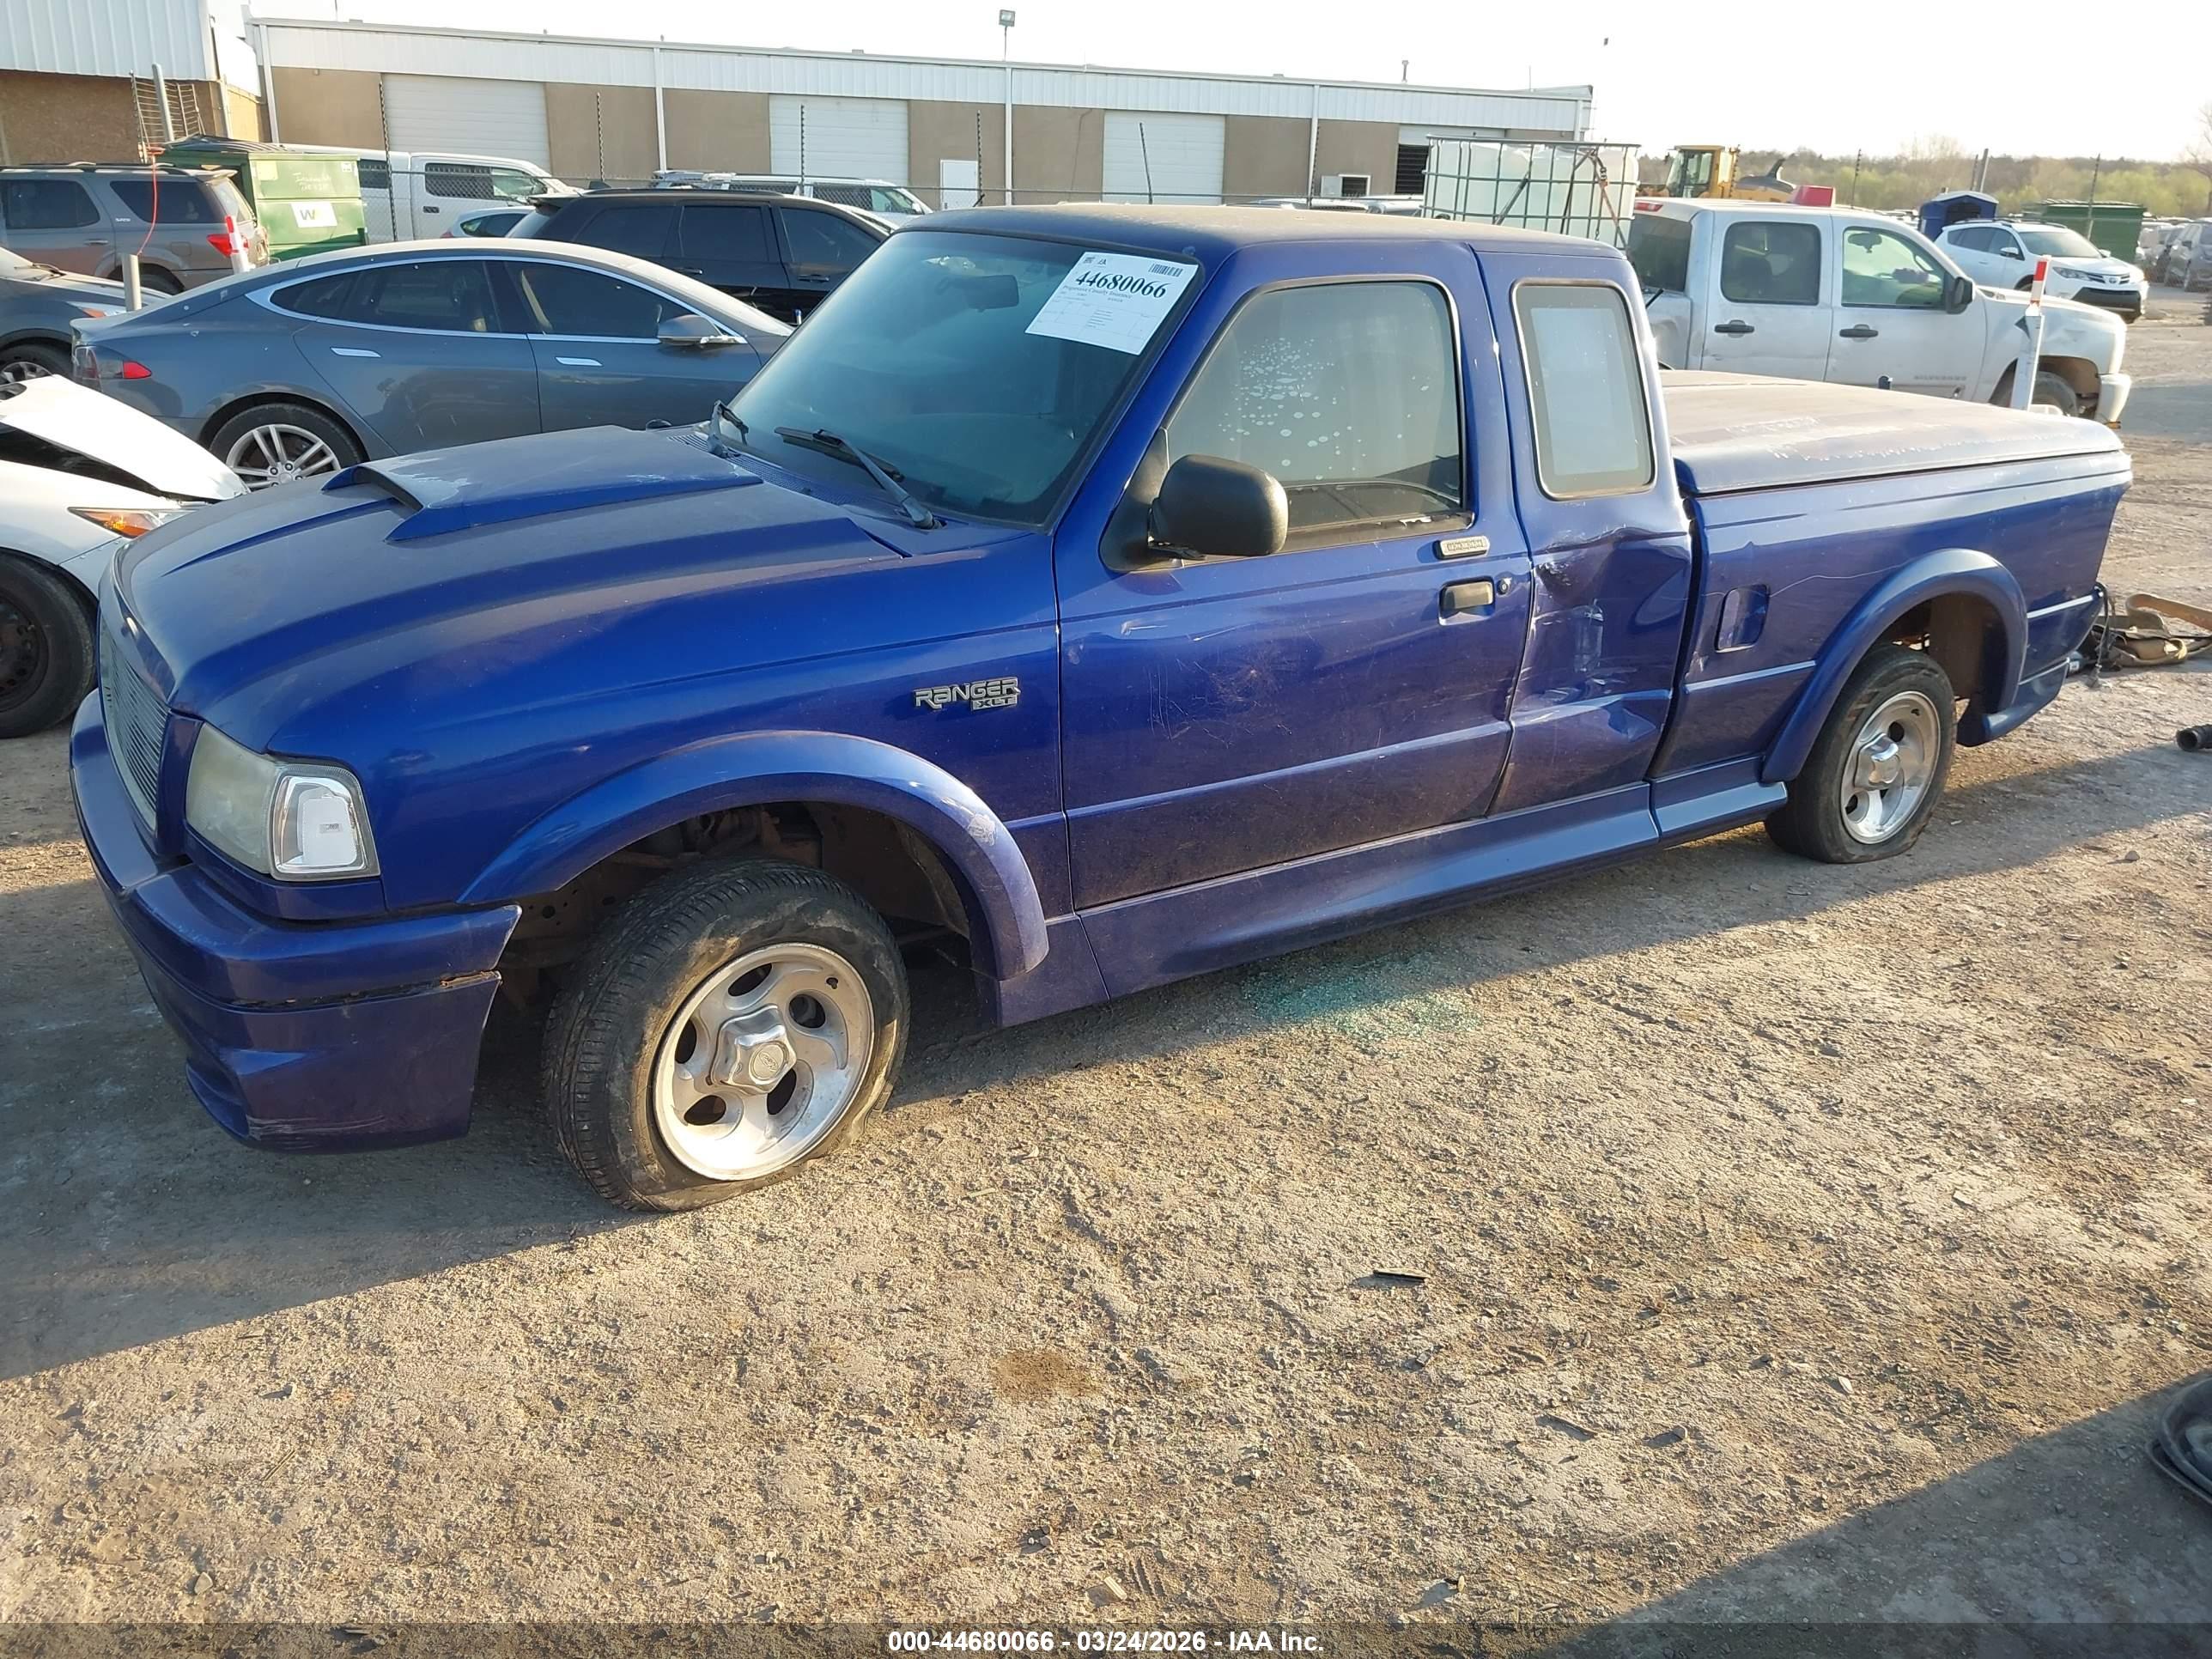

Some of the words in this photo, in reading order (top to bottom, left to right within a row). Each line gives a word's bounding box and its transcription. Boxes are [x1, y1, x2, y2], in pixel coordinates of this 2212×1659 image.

[1076, 270, 1172, 299] 44680066
[914, 677, 1021, 709] RANGER
[975, 696, 1017, 709] XLT
